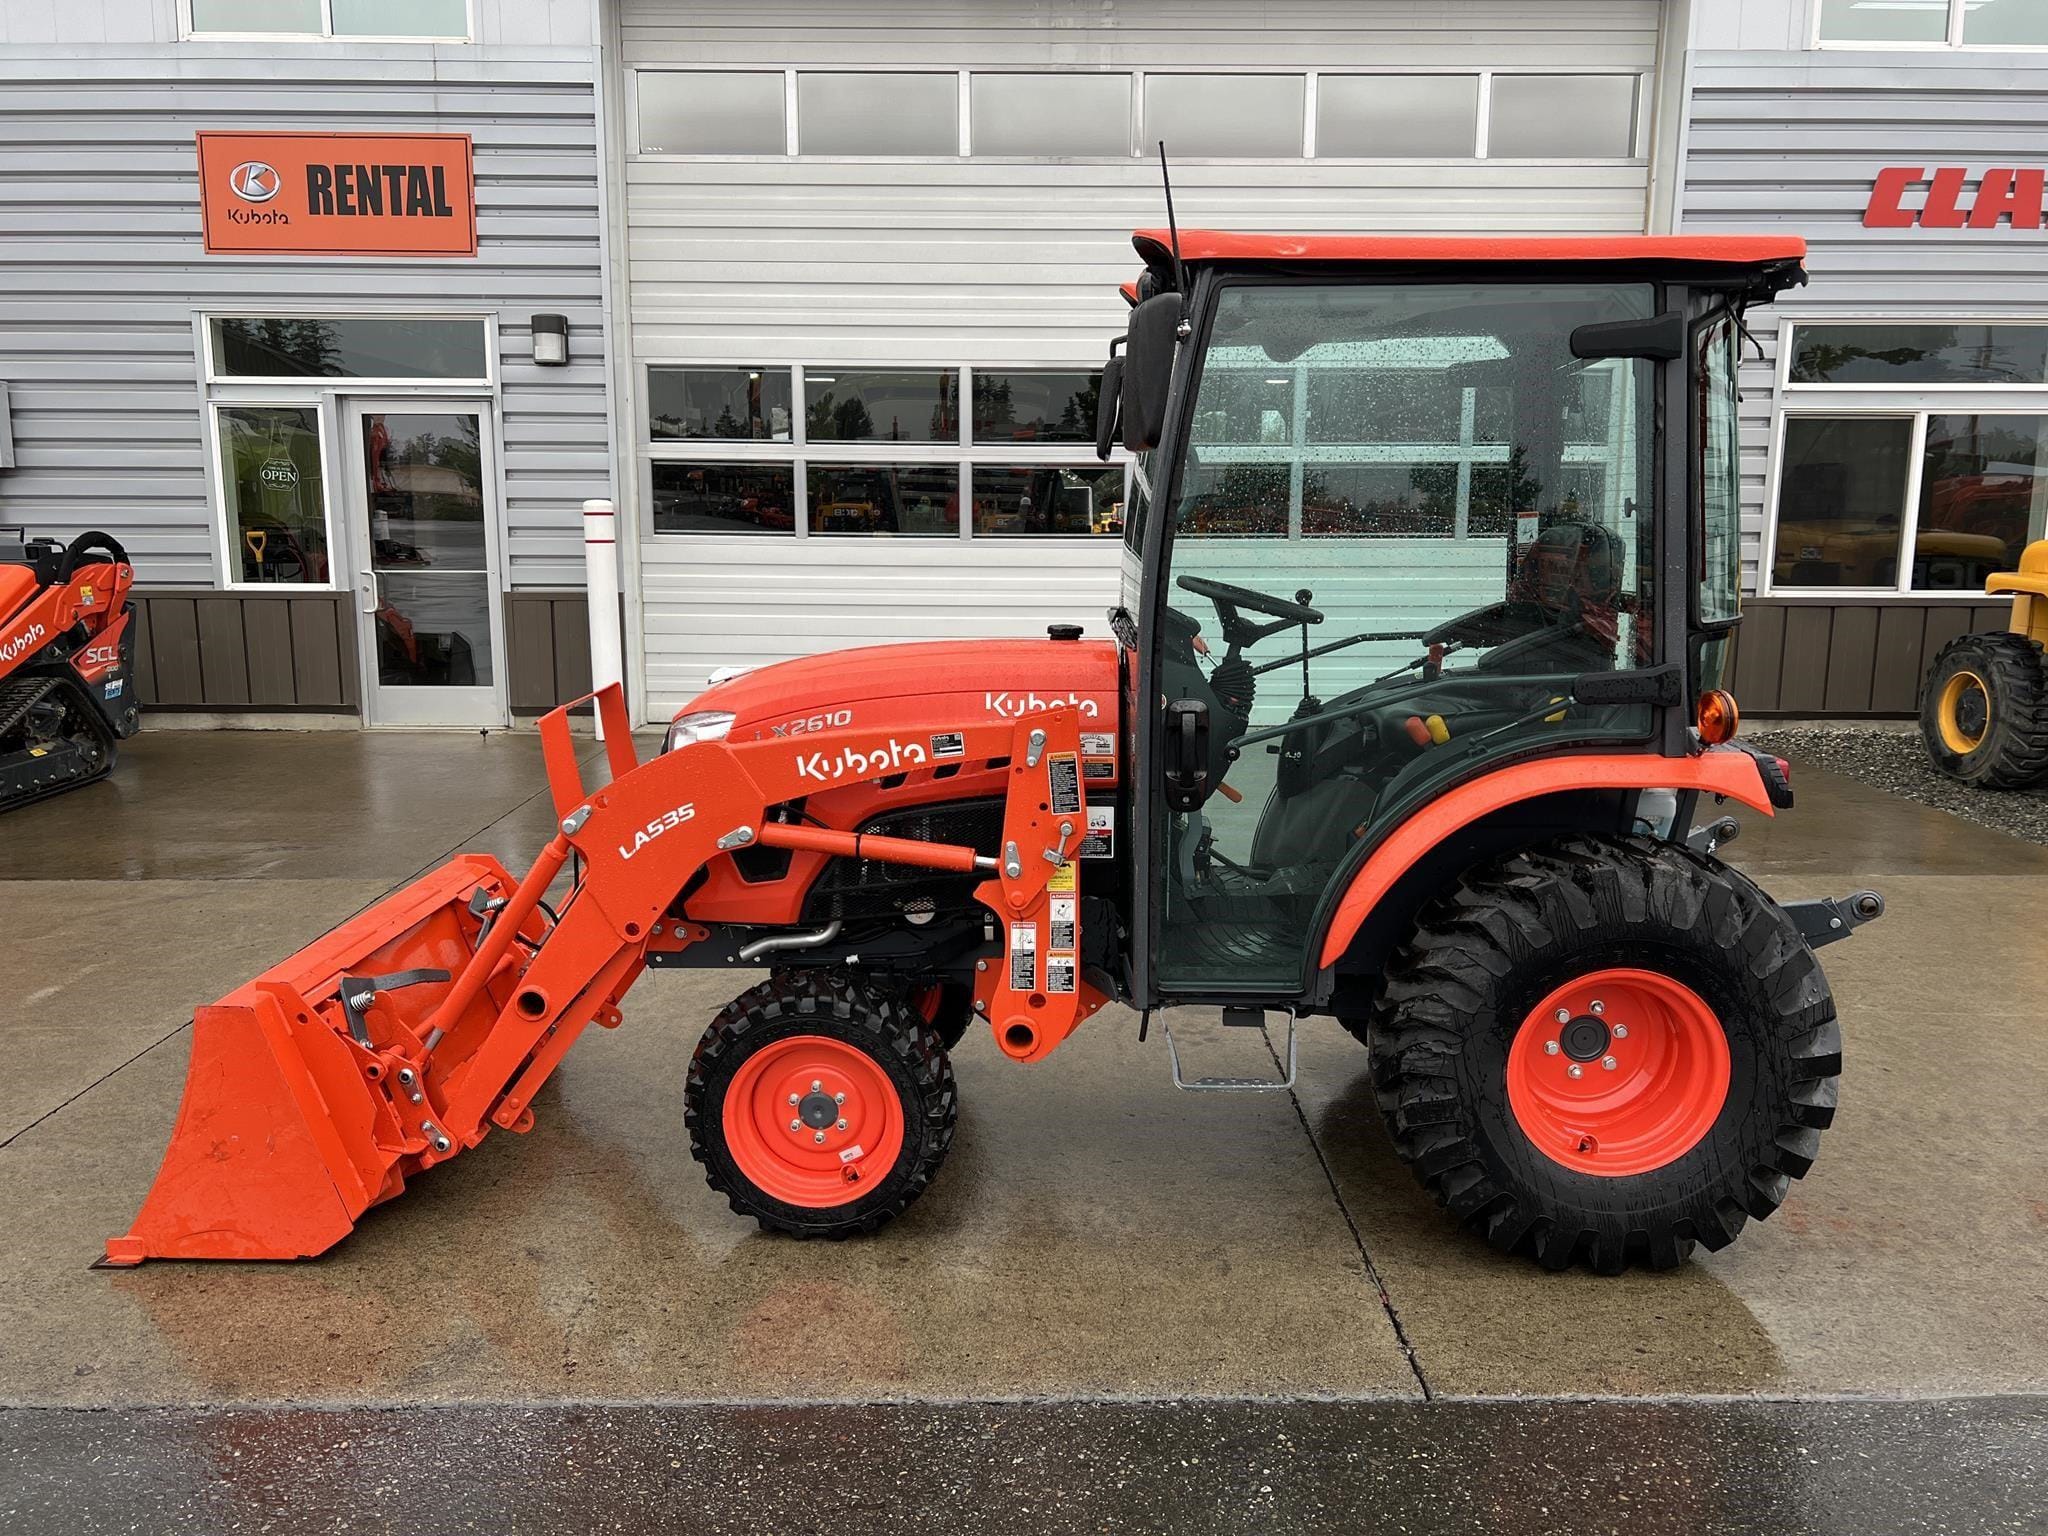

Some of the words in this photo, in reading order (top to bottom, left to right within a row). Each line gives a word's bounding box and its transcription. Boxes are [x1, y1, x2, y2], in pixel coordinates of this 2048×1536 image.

[306, 164, 453, 217] RENTAL
[1862, 167, 2048, 230] CLA
[227, 208, 289, 225] Kubota
[261, 469, 297, 482] OPEN
[0, 623, 46, 662] Kubota
[86, 646, 118, 665] SCL
[796, 738, 927, 782] Kubota
[618, 802, 696, 860] LA535
